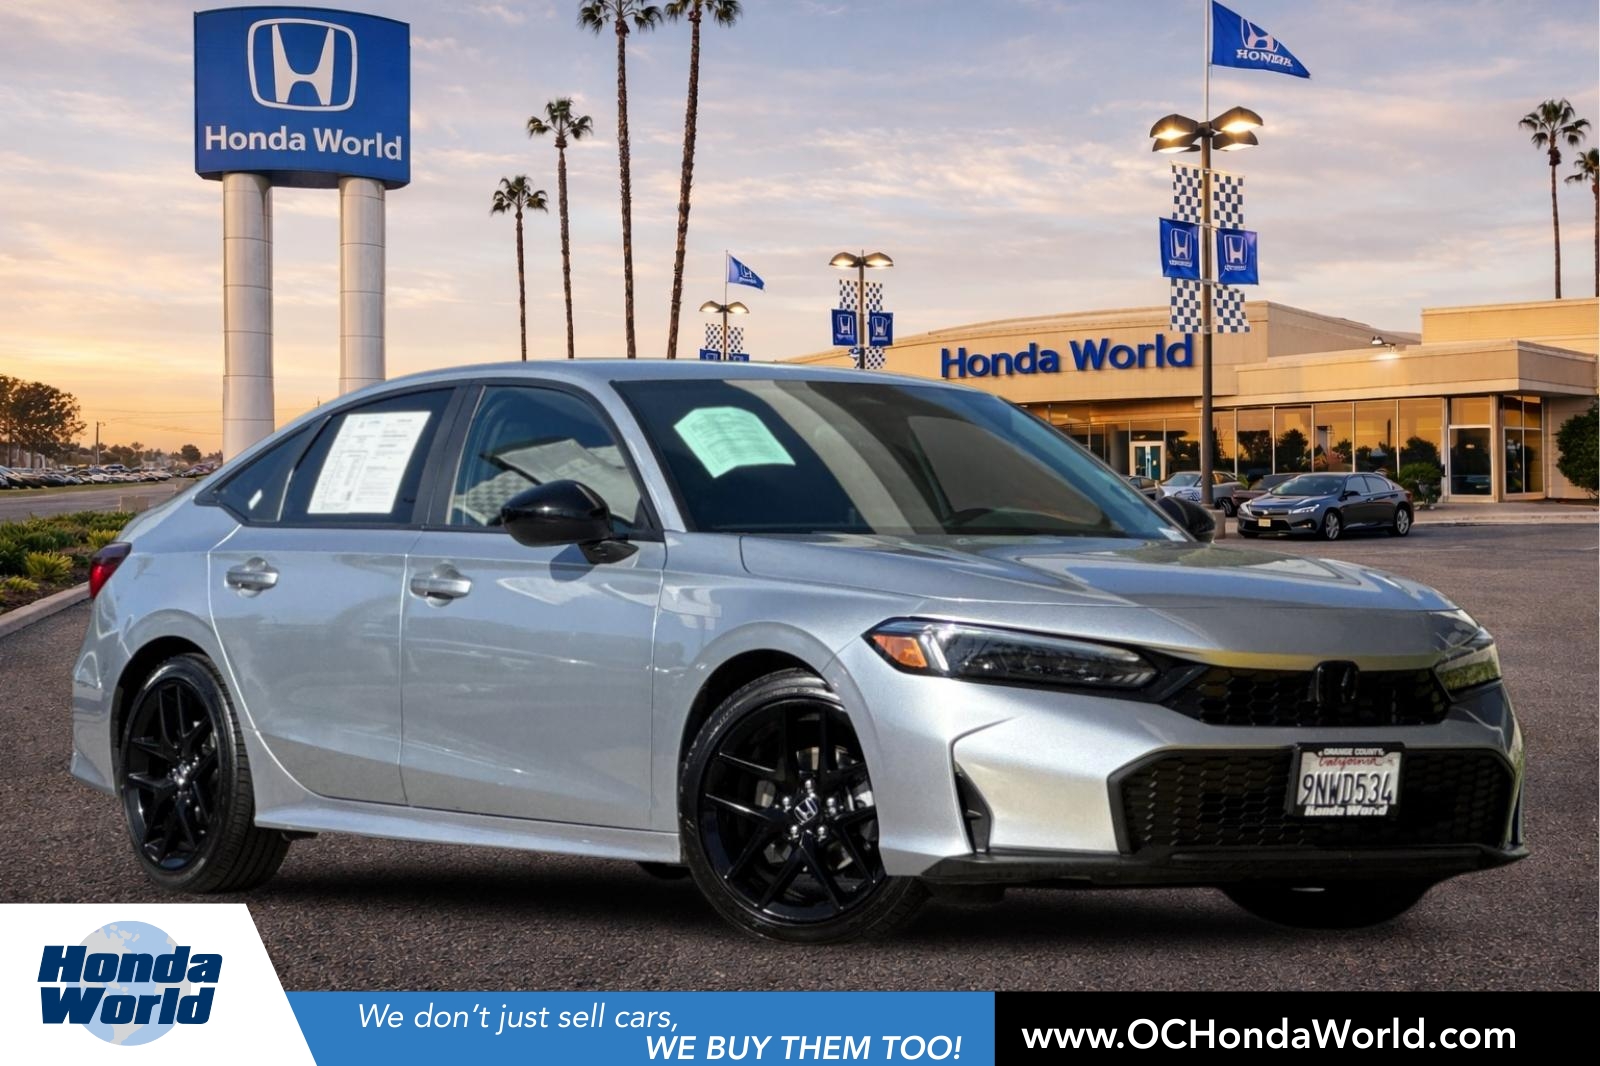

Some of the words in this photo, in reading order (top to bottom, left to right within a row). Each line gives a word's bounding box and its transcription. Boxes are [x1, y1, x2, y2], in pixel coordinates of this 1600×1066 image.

[205, 125, 306, 151] Honda
[312, 127, 402, 161] World
[941, 342, 1060, 379] Honda
[1069, 333, 1194, 372] World
[1301, 772, 1393, 806] 9NWD534
[1304, 805, 1346, 816] Honda
[1346, 805, 1388, 816] World
